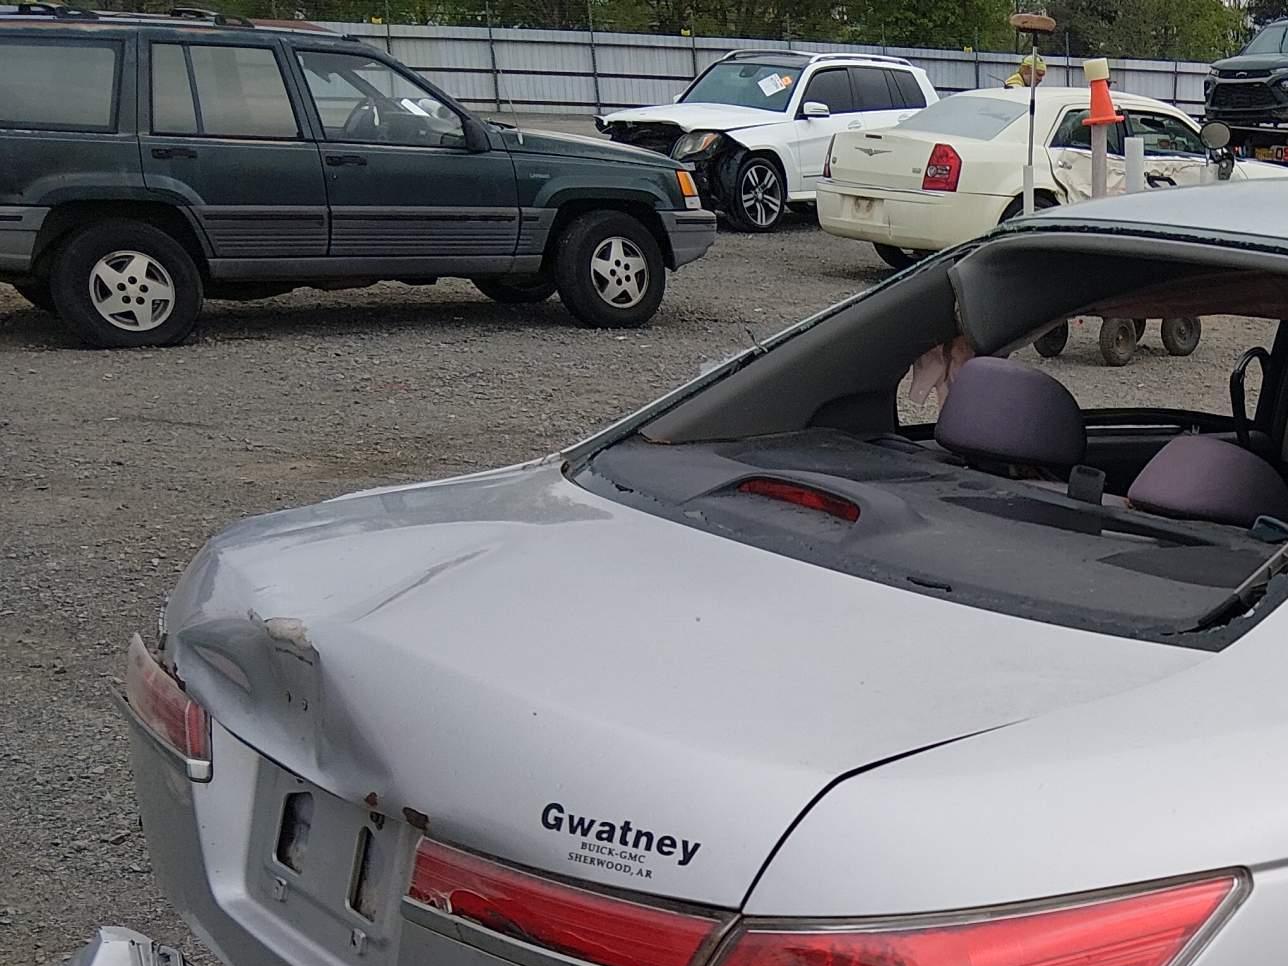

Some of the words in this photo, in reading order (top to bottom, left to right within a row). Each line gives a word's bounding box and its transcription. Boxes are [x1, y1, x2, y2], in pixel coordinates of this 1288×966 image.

[540, 802, 702, 867] Gwatney
[567, 851, 634, 876] SHERWOOD,
[636, 868, 653, 879] AR
[580, 841, 646, 864] BUICK-GMC
